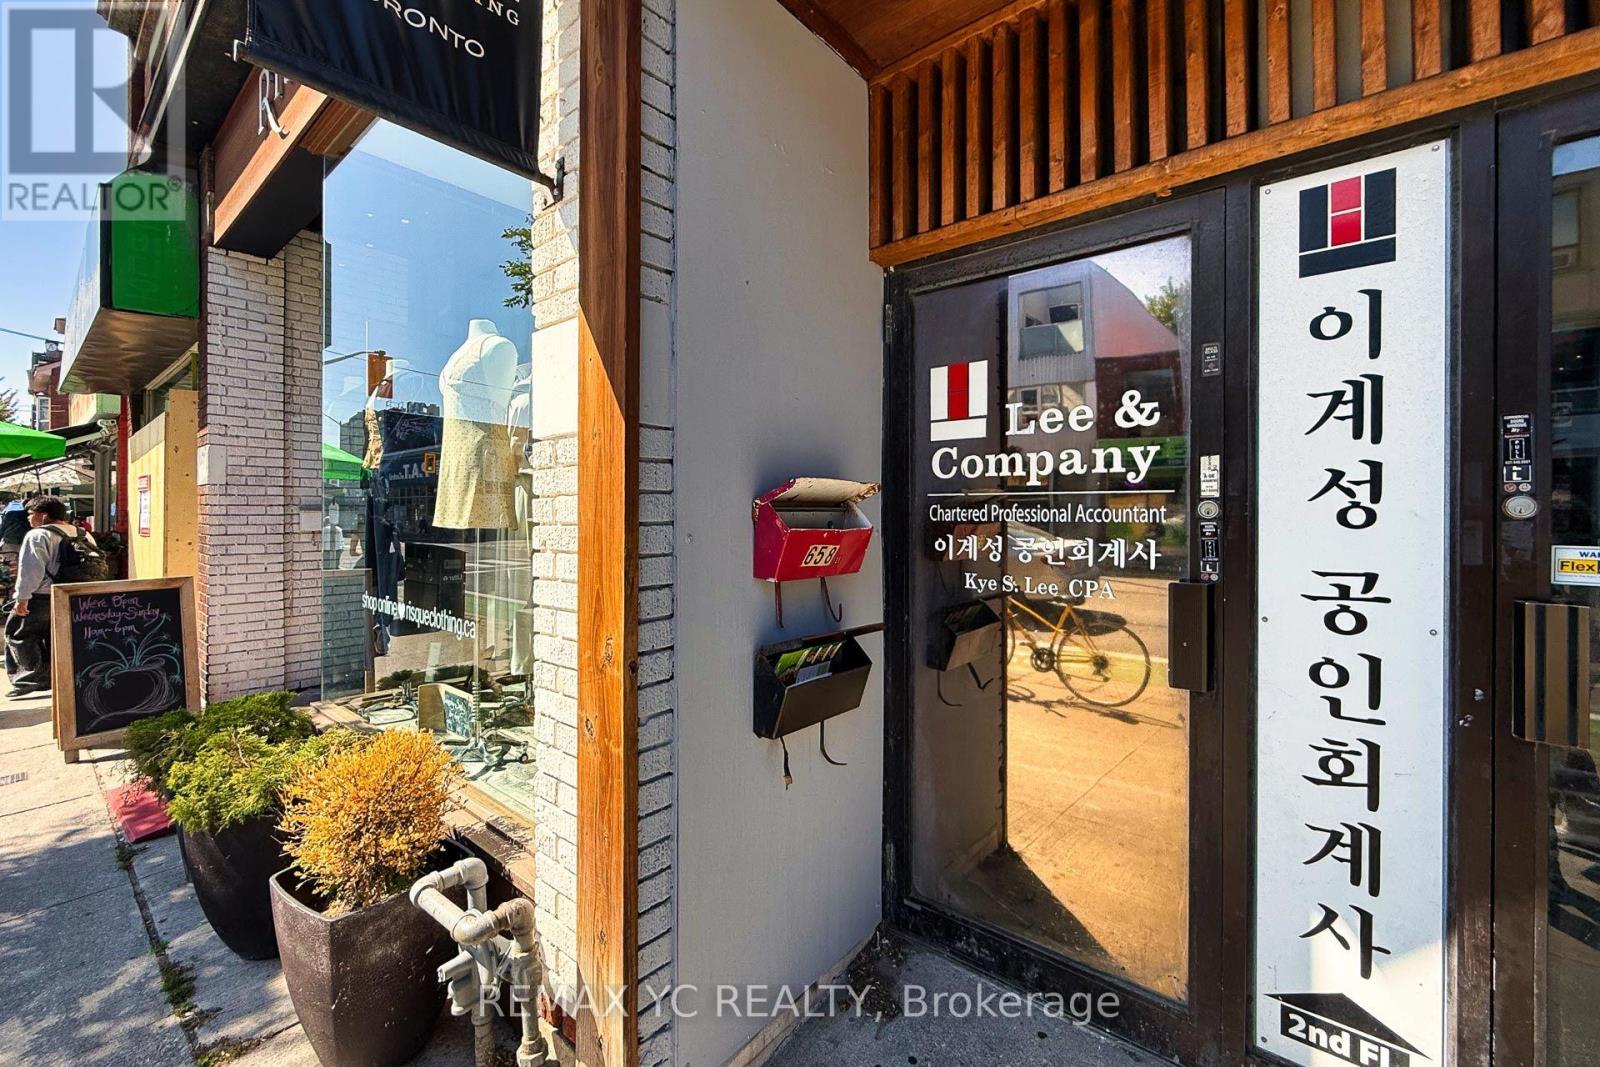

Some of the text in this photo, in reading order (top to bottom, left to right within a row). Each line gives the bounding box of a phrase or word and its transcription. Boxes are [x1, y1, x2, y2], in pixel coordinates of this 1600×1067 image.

[372, 0, 485, 58] RONTO
[474, 0, 520, 26] NG
[1005, 389, 1161, 436] Lee &
[1305, 288, 1384, 530] 이계성
[931, 445, 1161, 486] Company
[929, 504, 1167, 523] Chartered Professional Accountant
[803, 545, 838, 566] 658
[934, 534, 1162, 570] 이계성 공인회계사
[1560, 560, 1596, 572] Flex
[964, 572, 998, 593] Kye
[1024, 576, 1059, 595] Lee
[1069, 579, 1116, 599] CPA
[362, 590, 477, 641] shop online risqueclothing.ca
[1298, 570, 1392, 981] 공인회계사
[1288, 1013, 1351, 1058] 2nd
